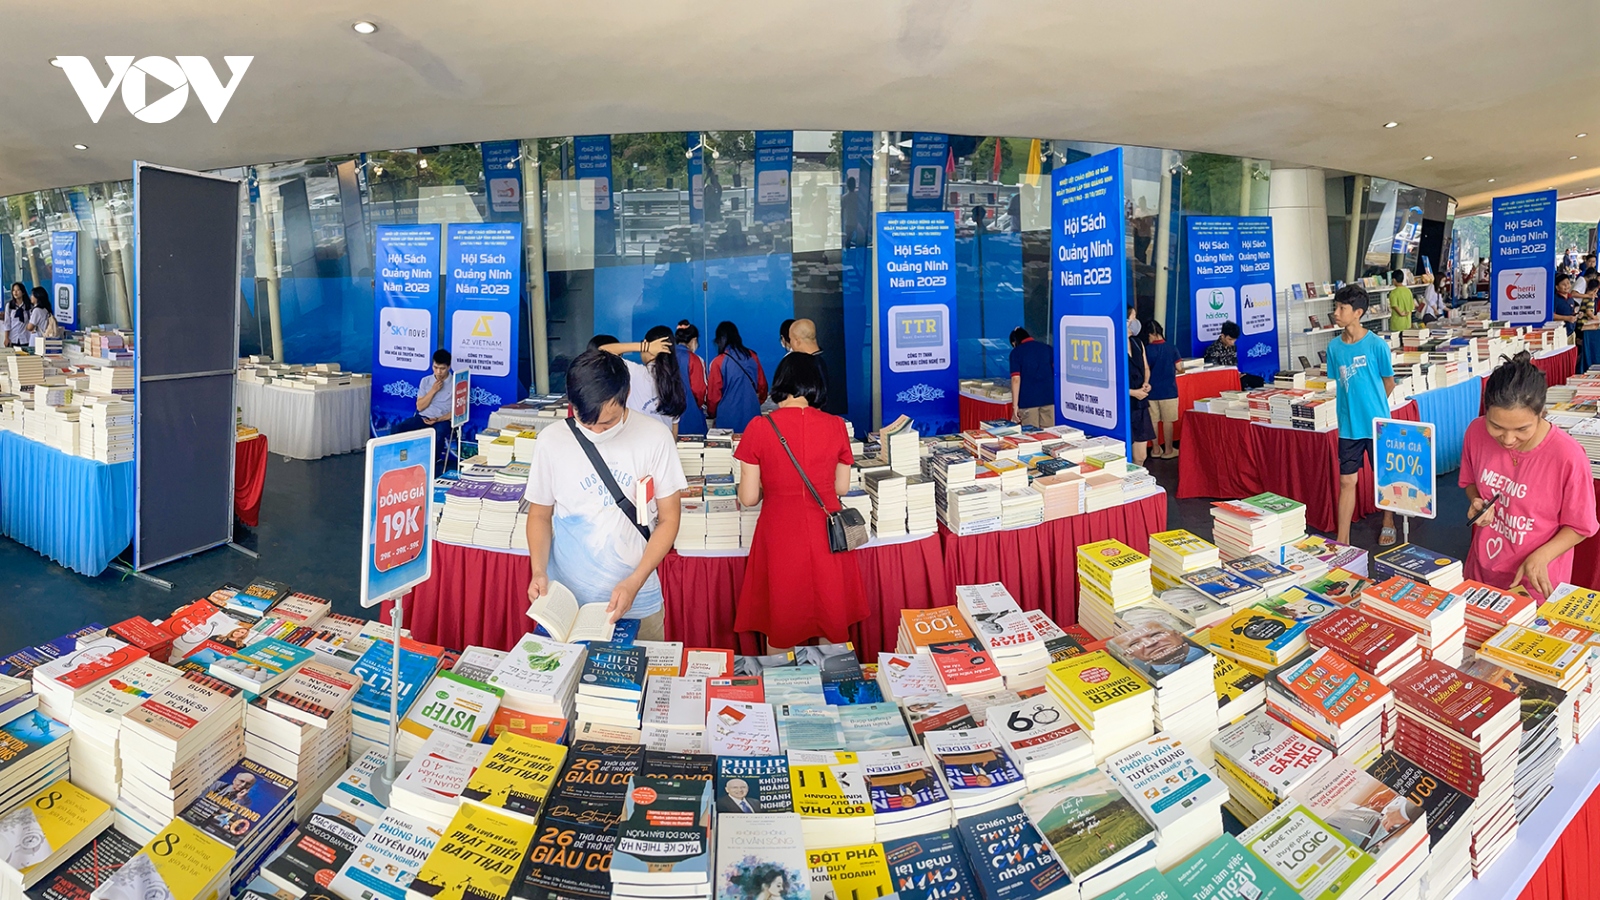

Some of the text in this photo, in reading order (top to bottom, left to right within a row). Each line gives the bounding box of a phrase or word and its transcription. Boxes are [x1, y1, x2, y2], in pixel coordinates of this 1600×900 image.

[1064, 212, 1106, 238] Hội Sách
[1504, 218, 1543, 231] Hội Sách
[1498, 231, 1548, 243] Quảng Ninh
[894, 244, 941, 258] Hội Sách
[1059, 239, 1113, 263] Quảng Ninh
[1199, 241, 1229, 251] Hội Sách
[1500, 244, 1546, 256] Năm 2023
[388, 254, 426, 265] Hội Sách
[462, 254, 505, 266] Hội Sách
[1195, 254, 1234, 263] Quảng Ninh
[382, 267, 432, 280] Quảng Ninh
[887, 260, 948, 274] Quảng Ninh
[1197, 265, 1233, 275] Năm 2023
[454, 268, 512, 282] Quảng Ninh
[890, 276, 947, 288] Năm 2023
[1061, 267, 1112, 286] Năm 2023
[384, 282, 430, 292] Năm 2023
[456, 283, 510, 294] Năm 2023
[1517, 292, 1535, 300] books
[902, 319, 937, 334] TTR
[1070, 339, 1103, 364] TTR
[1386, 438, 1422, 453] GIẢM GIÁ
[1385, 453, 1423, 476] 50%
[580, 473, 597, 490] LOS
[1480, 469, 1527, 498] MEETING
[380, 483, 424, 508] ĐỒNG GIÁ
[382, 505, 420, 543] 19K
[1505, 513, 1534, 530] NICE
[914, 617, 958, 635] 100
[988, 630, 1034, 642] TRACY
[990, 634, 1036, 648] BRIAN
[595, 652, 640, 664] SHIFT
[1533, 648, 1546, 659] 4.0
[589, 667, 637, 679] MAXWELL
[592, 660, 638, 672] LEADER
[1082, 675, 1131, 696] CONNECTOR
[1297, 666, 1329, 690] LÀM
[1423, 673, 1439, 684] năng
[1439, 672, 1458, 684] hàng
[187, 683, 213, 698] BURN
[1087, 680, 1142, 704] SUPER
[1313, 674, 1343, 699] VIỆC
[163, 690, 210, 713] BUSINESS
[165, 700, 191, 714] PLAN
[421, 701, 477, 733] VSTEP
[1036, 726, 1074, 744] TƯỞNG
[937, 741, 993, 753] JOE BIDEN
[1248, 746, 1271, 762] MÔ HÌNH
[422, 759, 443, 770] 4.0
[571, 758, 602, 771] 26
[721, 758, 786, 768] PHILIP
[1119, 744, 1172, 775] PHỎNG VẤN
[1268, 740, 1307, 775] SÁNG
[1293, 745, 1323, 770] TẠO
[721, 766, 788, 775] KOTLER
[866, 760, 924, 774] JOE BIDEN
[1126, 748, 1185, 783] TUYỂN DỤNG
[565, 768, 609, 785] GIÀU
[759, 784, 790, 792] HOẢNG
[35, 791, 62, 810] 8
[760, 793, 791, 801] DOANH
[205, 790, 261, 822] MARKETING
[760, 801, 792, 809] NGHIỆP
[976, 818, 1006, 831] Chiến
[1283, 817, 1305, 841] THUẬT
[379, 822, 435, 849] PHỎNG VẤN
[539, 827, 576, 846] 26
[626, 829, 650, 840] MUỐN
[730, 835, 794, 845] TÔI VẪN SỐNG
[152, 833, 180, 857] 8
[365, 842, 393, 858] CHUYÊN
[373, 832, 405, 853] TUYỂN
[450, 830, 521, 862] PHÁT TRIỂN
[634, 839, 700, 854] MẶC THIÊN
[1275, 829, 1312, 859] thuyết phục
[530, 845, 582, 868] GIÀU
[809, 846, 878, 865] ĐỘT PHÁ
[1282, 831, 1329, 871] LOGIC
[811, 870, 877, 882] KINH DOANH
[827, 864, 846, 873] DUY
[998, 862, 1035, 881] nhân
[1193, 883, 1215, 900] Tuần
